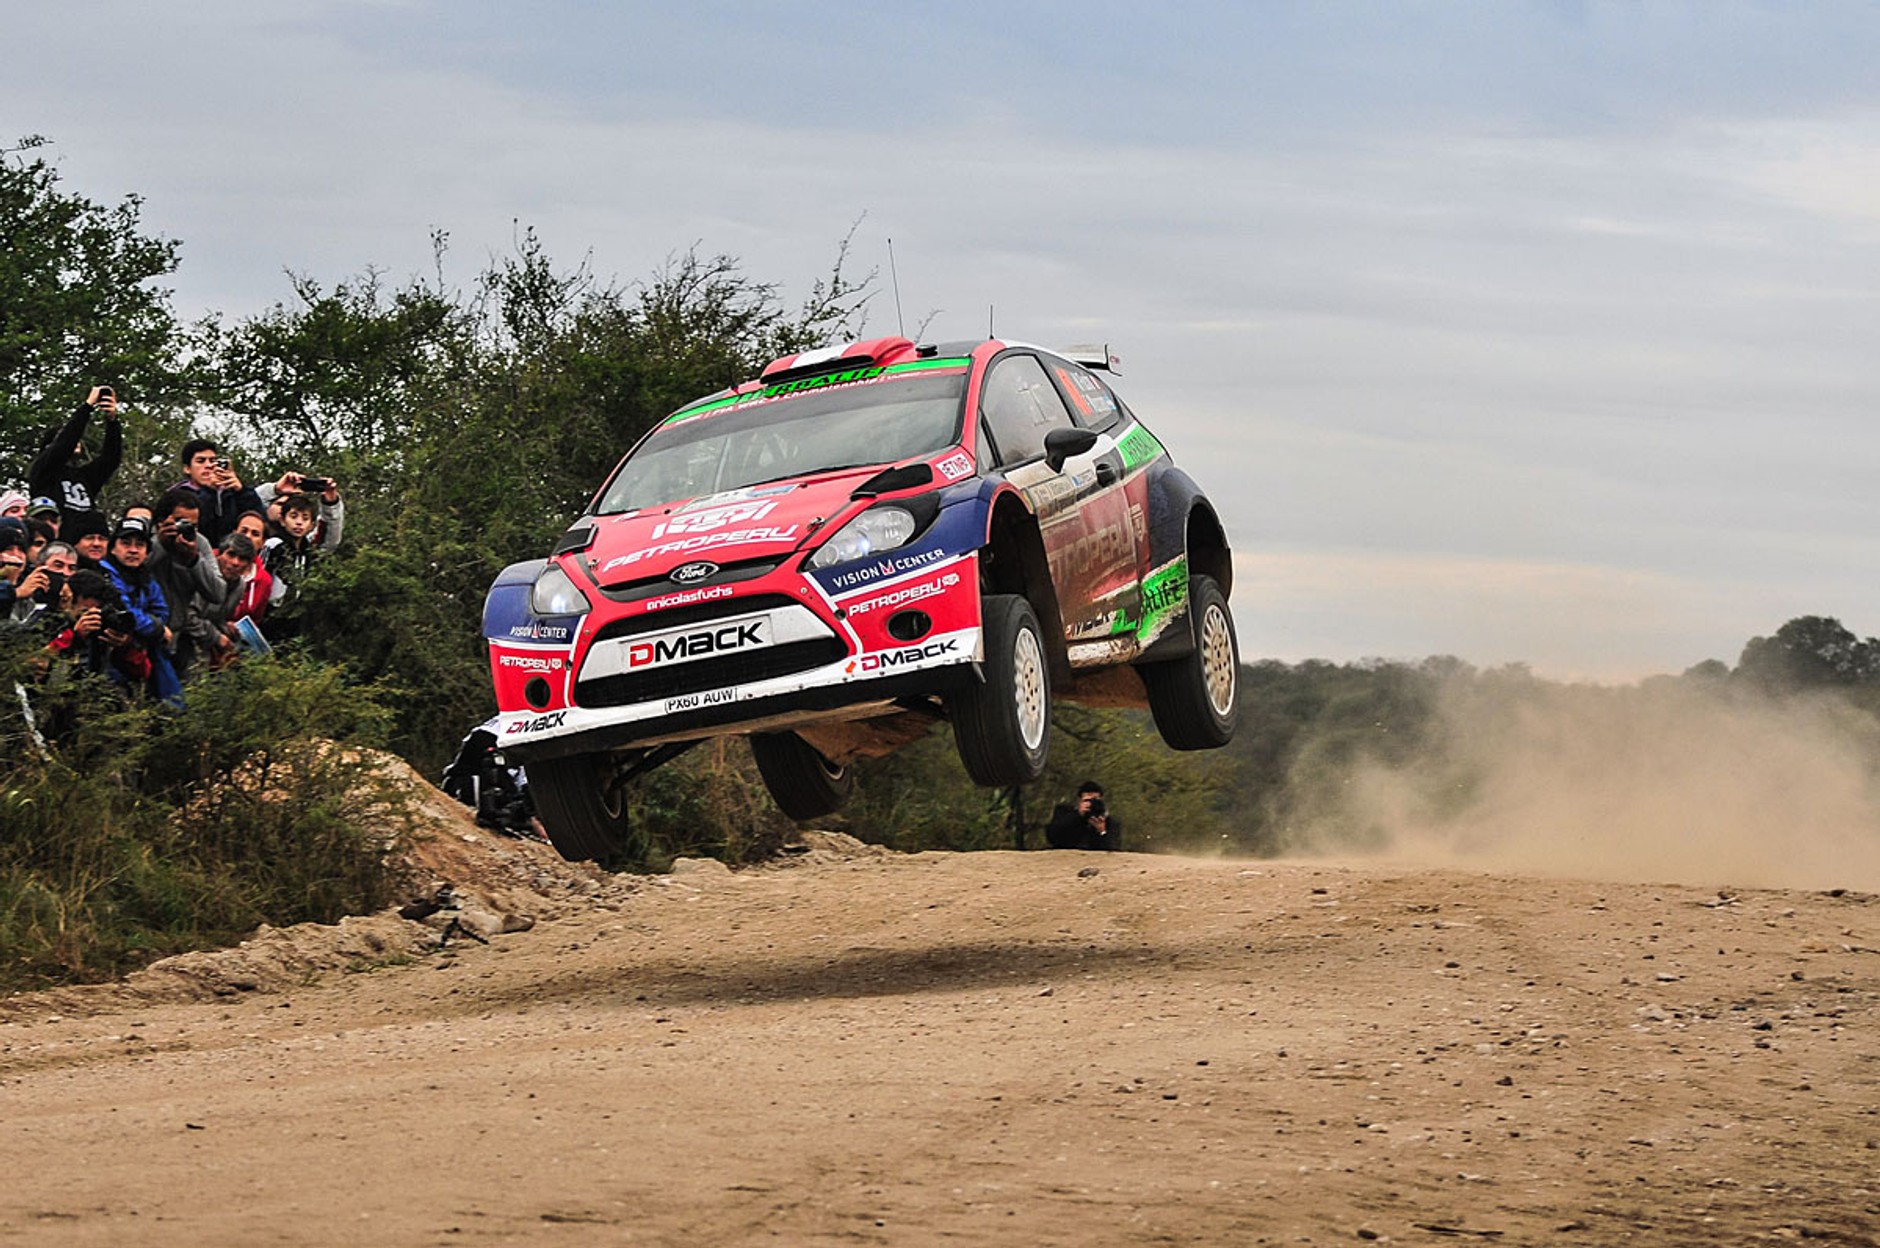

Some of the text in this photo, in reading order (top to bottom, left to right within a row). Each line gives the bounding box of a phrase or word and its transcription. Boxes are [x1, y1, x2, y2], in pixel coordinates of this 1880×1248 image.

[602, 525, 799, 573] PETROPERU
[679, 564, 707, 580] Ford
[832, 548, 946, 589] VISION CENTER
[849, 577, 942, 617] PETROPERU
[510, 625, 567, 639] VISION CENTER
[499, 654, 551, 670] PETROPERU
